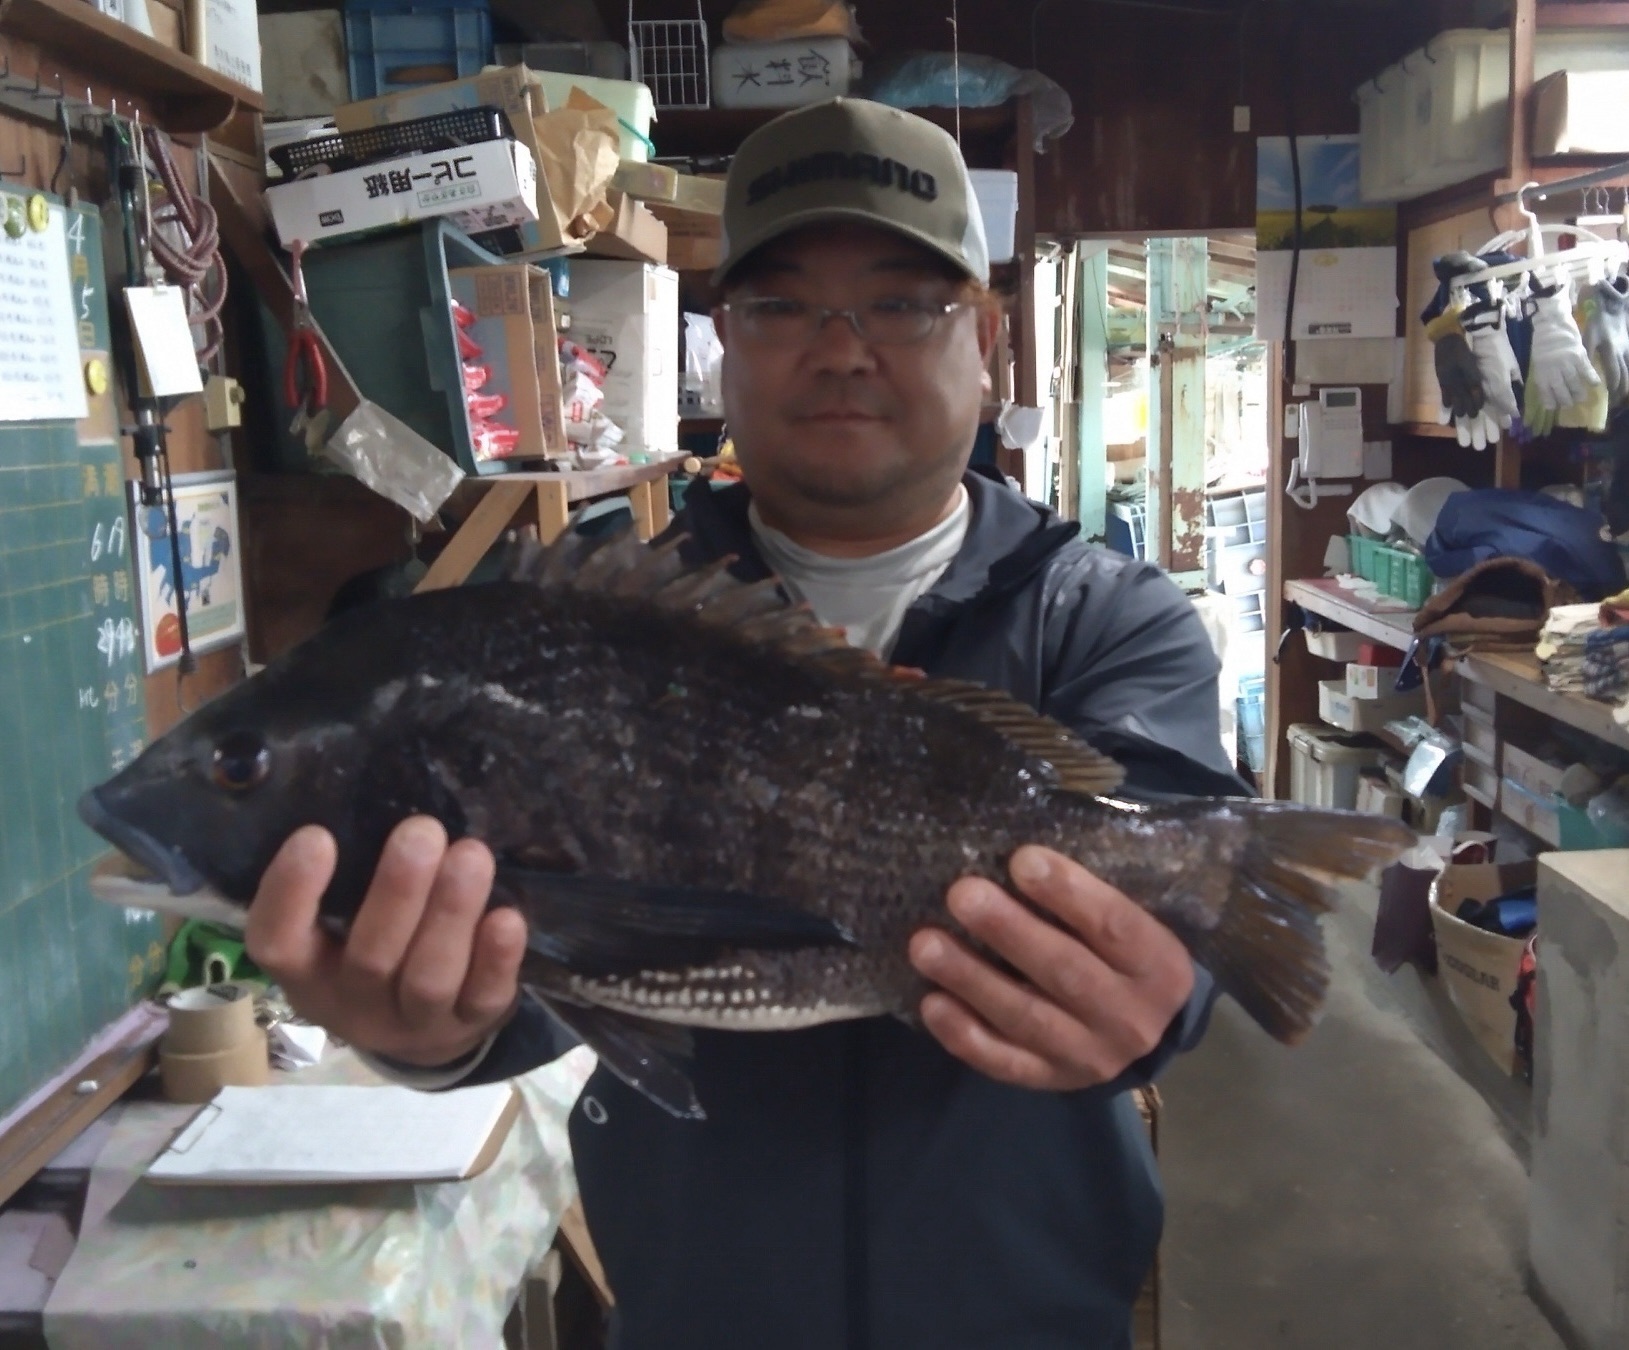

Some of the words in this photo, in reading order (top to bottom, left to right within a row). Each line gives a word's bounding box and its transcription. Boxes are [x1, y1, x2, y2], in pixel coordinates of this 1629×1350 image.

[363, 156, 477, 198] コピー用紙
